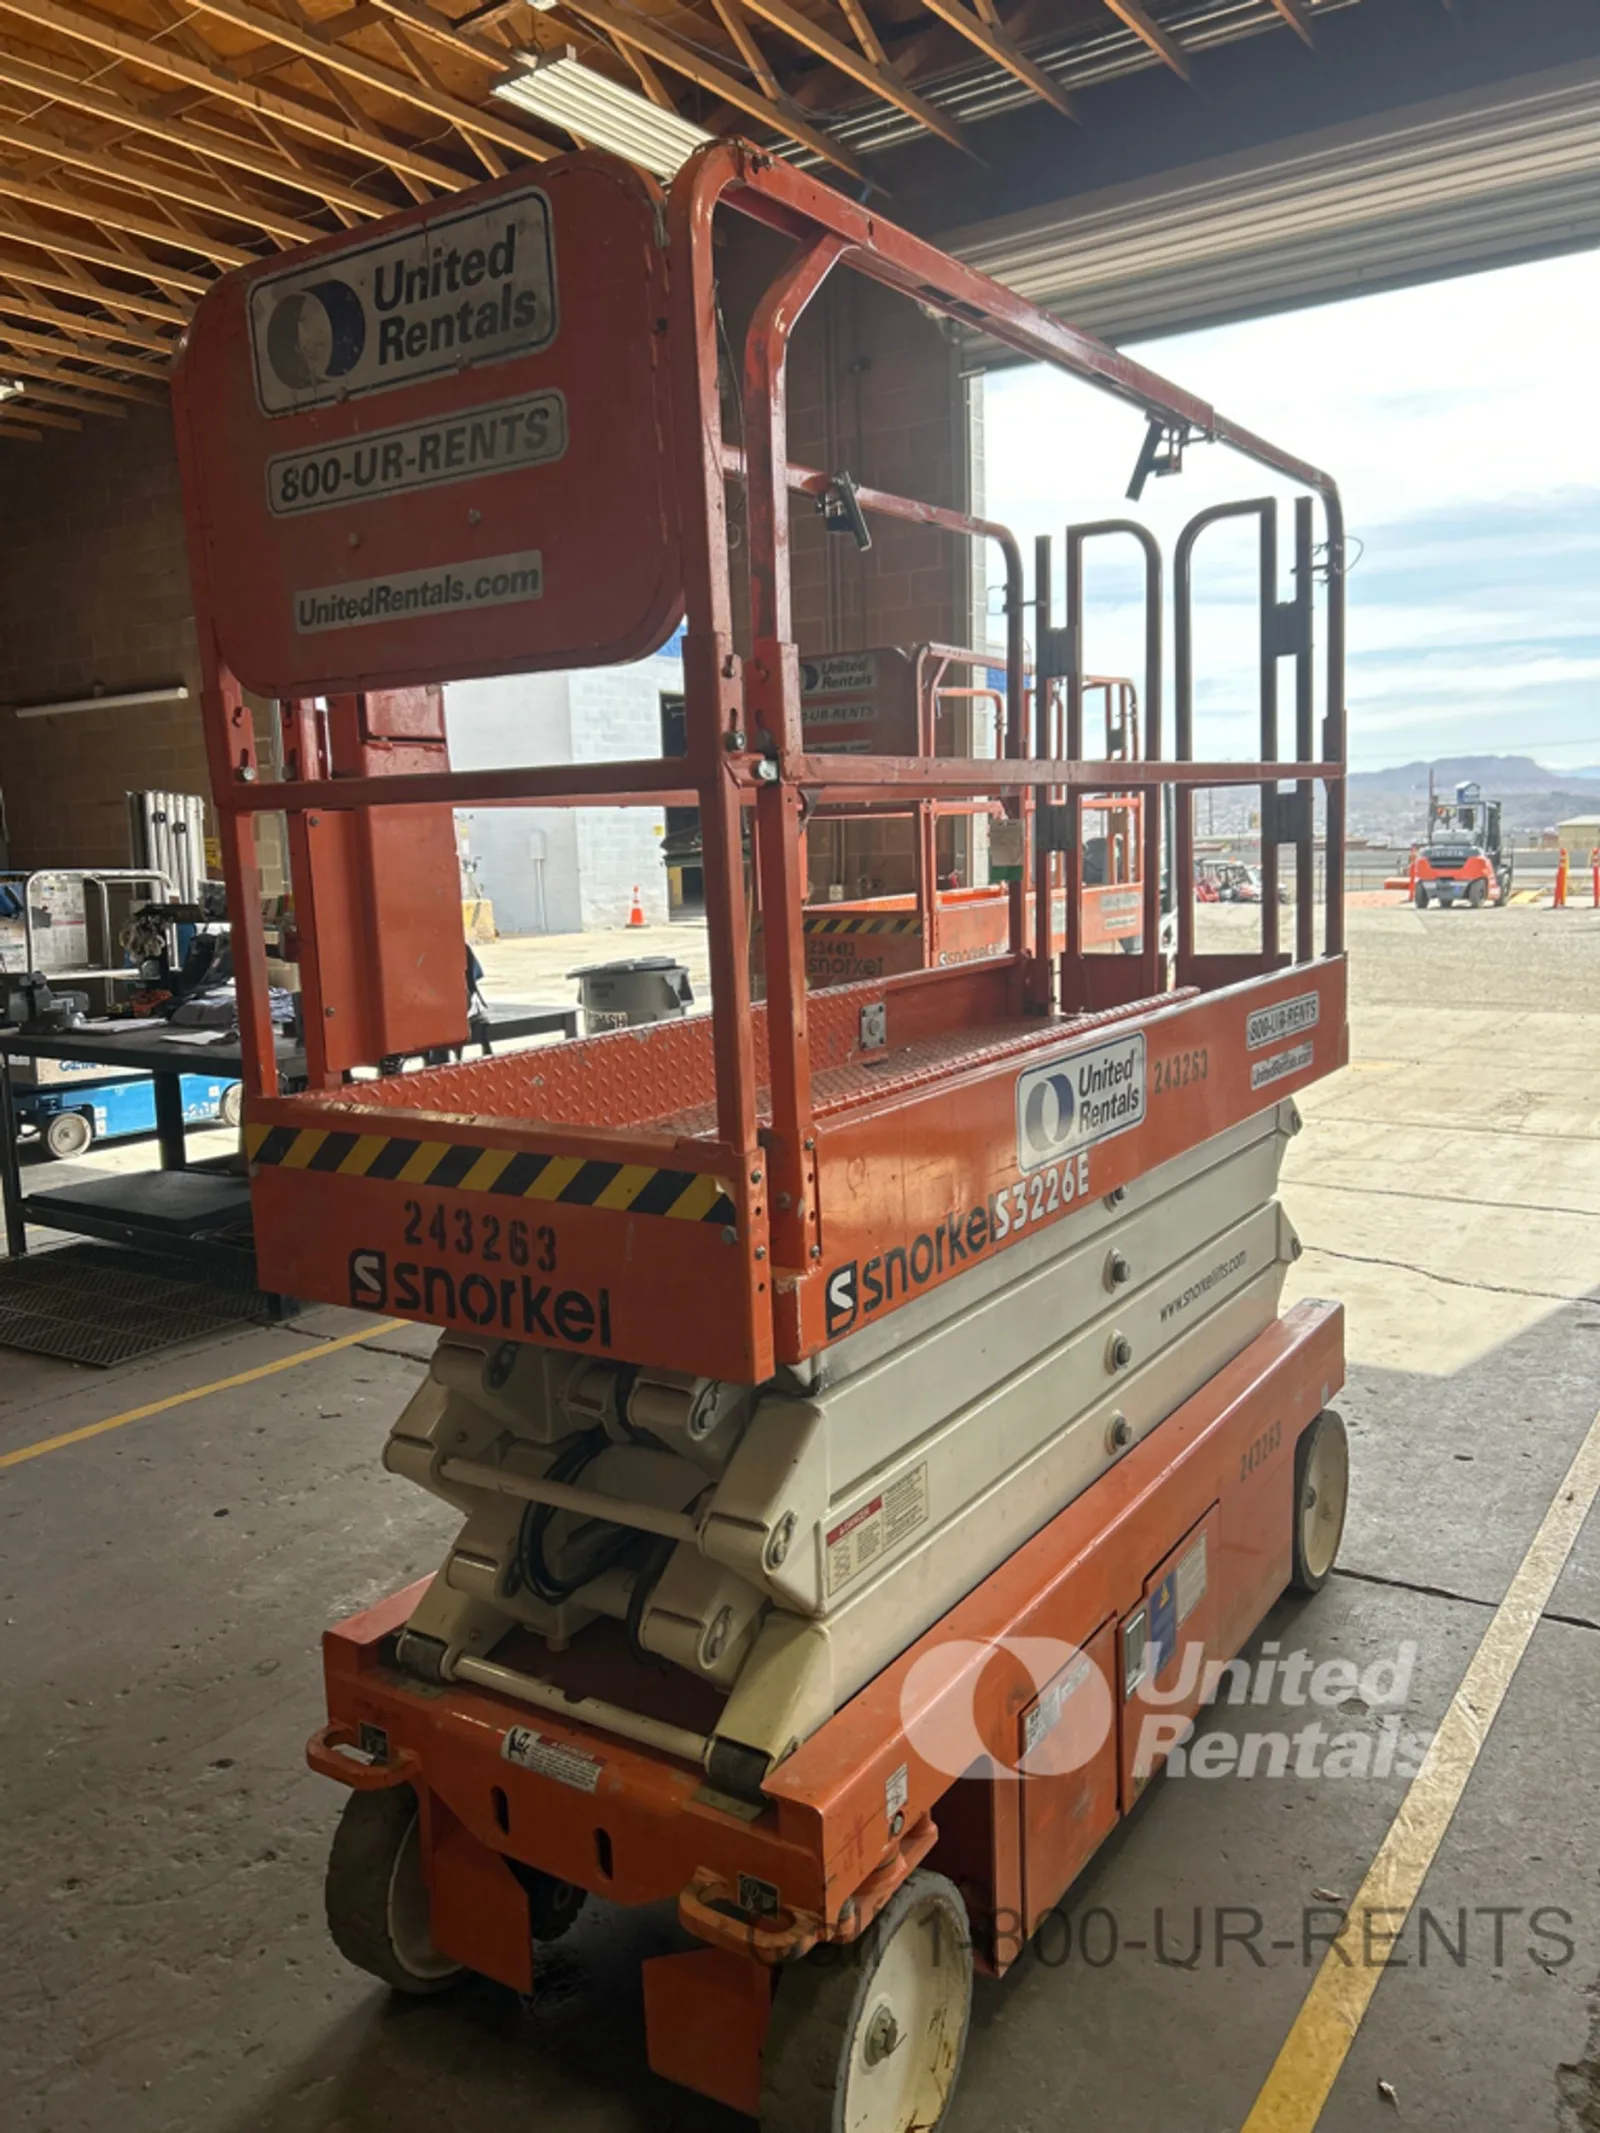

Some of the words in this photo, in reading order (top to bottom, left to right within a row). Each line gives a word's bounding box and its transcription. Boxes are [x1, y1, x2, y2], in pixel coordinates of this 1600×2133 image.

[373, 223, 517, 312] United
[377, 282, 538, 367] Rentals
[279, 406, 551, 505] 800-UR-RENTS
[298, 566, 540, 628] UnitedRentals.com
[1078, 1049, 1136, 1097] United
[1078, 1084, 1140, 1134] Rentals
[1153, 1048, 1209, 1095] 243263
[403, 1199, 557, 1272] 243263
[863, 1193, 996, 1314] snorkel
[994, 1150, 1090, 1241] S3226E
[393, 1260, 612, 1348] snorkel
